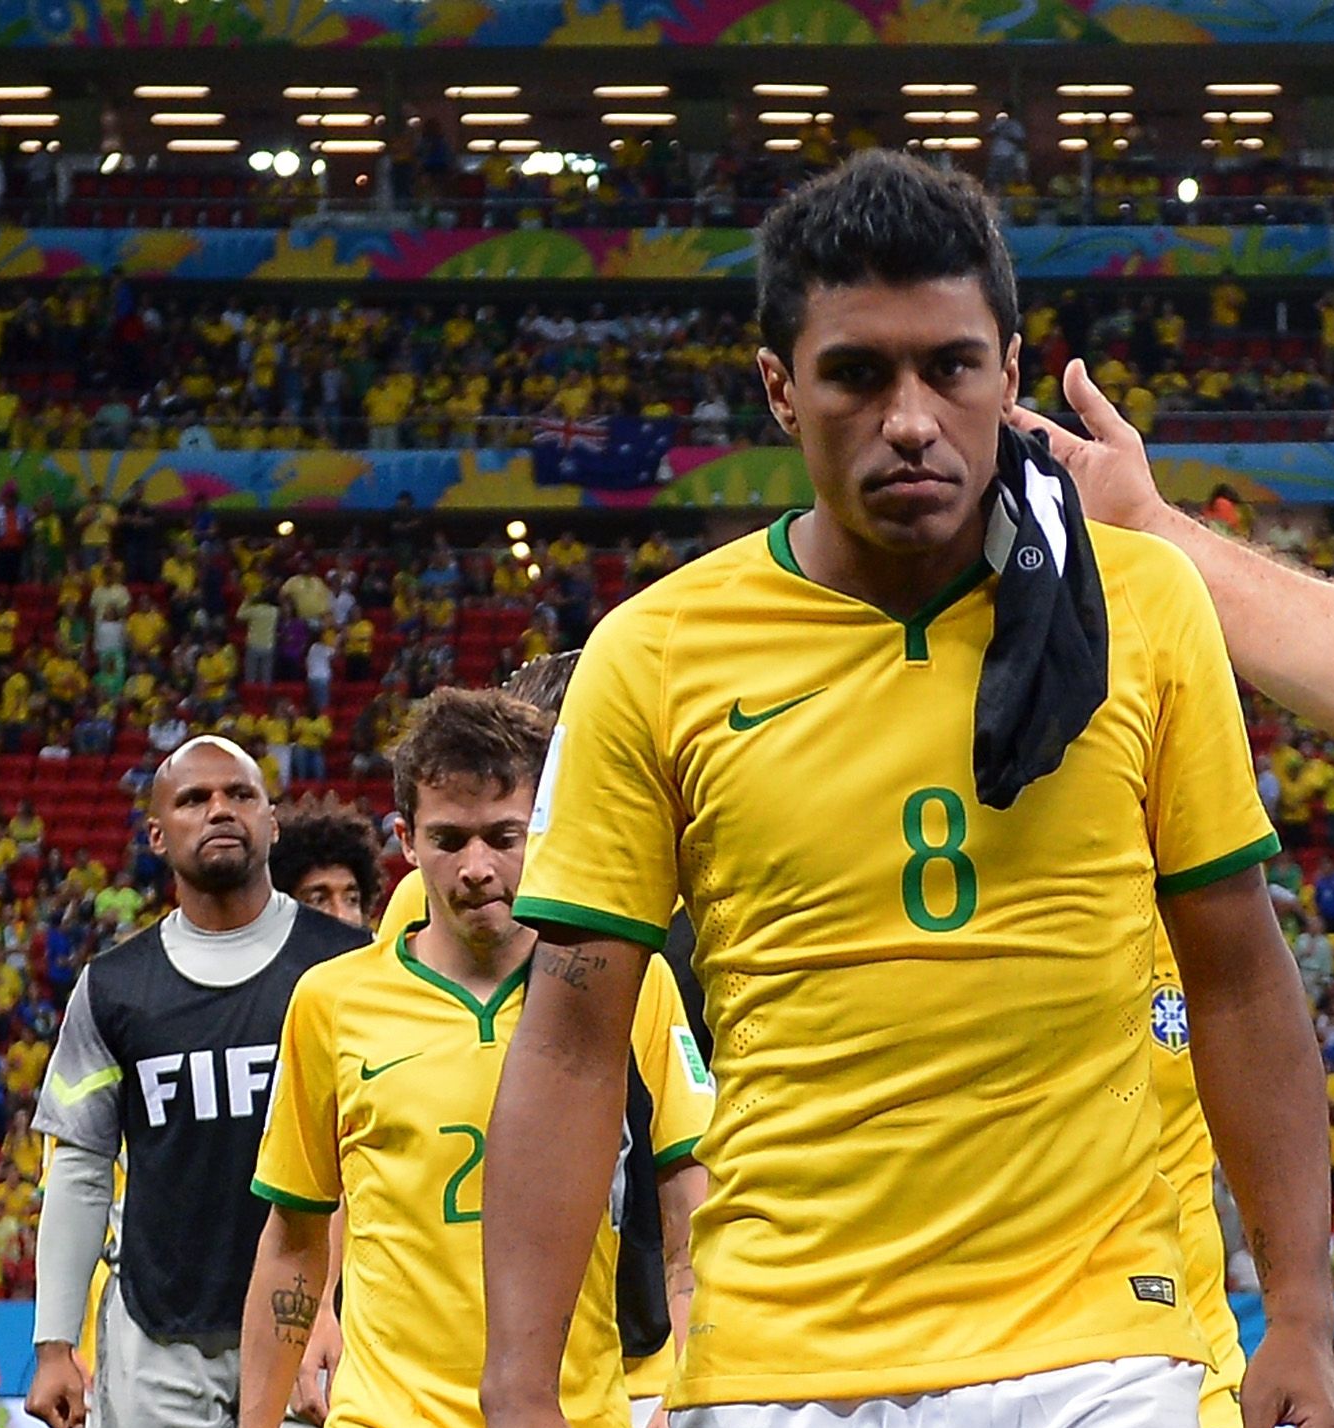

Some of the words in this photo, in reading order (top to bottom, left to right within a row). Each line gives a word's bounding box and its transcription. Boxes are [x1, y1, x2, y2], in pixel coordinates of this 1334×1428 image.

[901, 786, 978, 933] 8
[136, 1044, 278, 1128] FIF
[439, 1124, 485, 1224] 2
